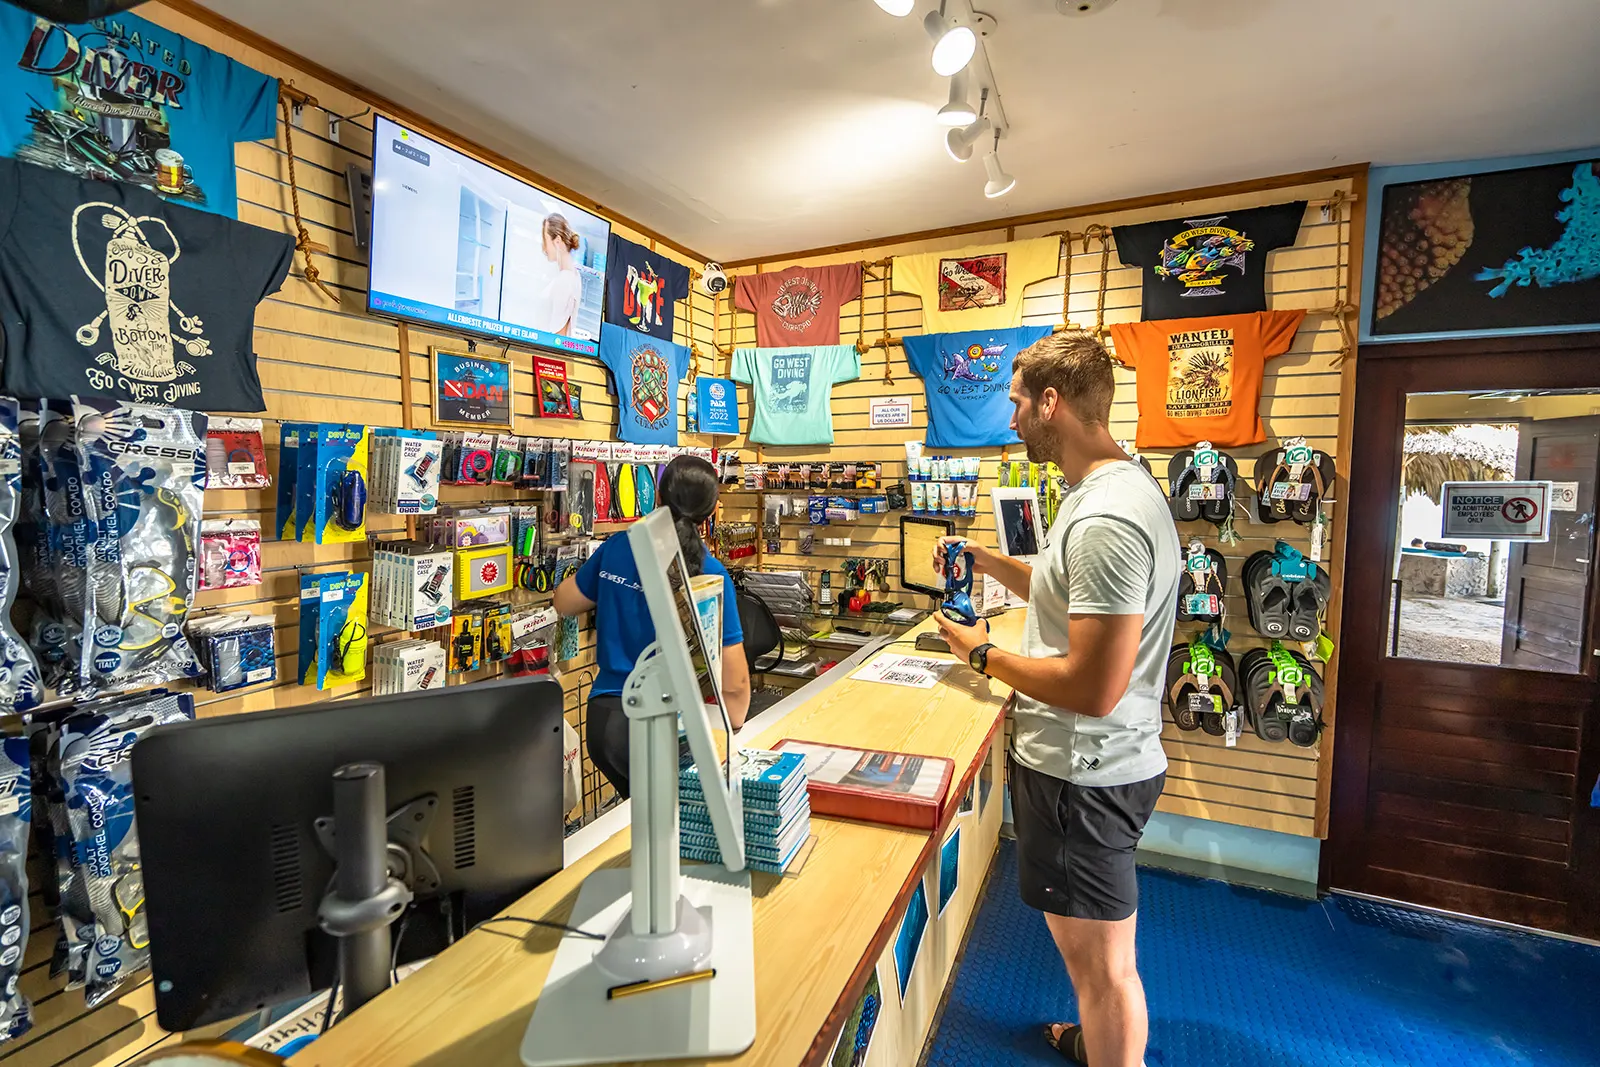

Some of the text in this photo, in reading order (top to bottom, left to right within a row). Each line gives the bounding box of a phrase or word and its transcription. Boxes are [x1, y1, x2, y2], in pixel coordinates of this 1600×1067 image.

[88, 19, 192, 76] GNATED
[18, 17, 185, 109] DIVER
[1180, 227, 1230, 239] GO WEST DIVING
[109, 259, 166, 288] DIVER
[123, 286, 153, 301] DOWN
[115, 328, 168, 345] BOTTOM
[1170, 330, 1229, 344] WANTED
[148, 341, 167, 354] TIME
[454, 361, 494, 378] BUSINESS
[774, 357, 811, 368] GO WEST
[777, 368, 805, 379] DIVING
[86, 368, 201, 402] GO WEST DIVING
[463, 381, 503, 402] DAN
[938, 383, 1011, 394] GO WEST DIVING
[1177, 388, 1221, 400] LIONFISH
[458, 408, 491, 420] MEMBER
[710, 412, 728, 420] 2022
[108, 441, 197, 460] CRESSI
[68, 477, 82, 515] COMBO
[103, 471, 116, 510] COMBO
[1456, 496, 1500, 504] NOTICE
[73, 518, 88, 568] SNORKEL
[96, 530, 106, 562] ADULT
[106, 513, 120, 563] SNORKEL
[62, 534, 76, 567] ADULT
[523, 616, 547, 630] TRIDENT
[97, 658, 119, 669] ITALY
[88, 790, 104, 828] COMBO
[96, 830, 110, 877] SNORKEL
[86, 848, 99, 877] ADULT
[97, 962, 120, 975] ITALY
